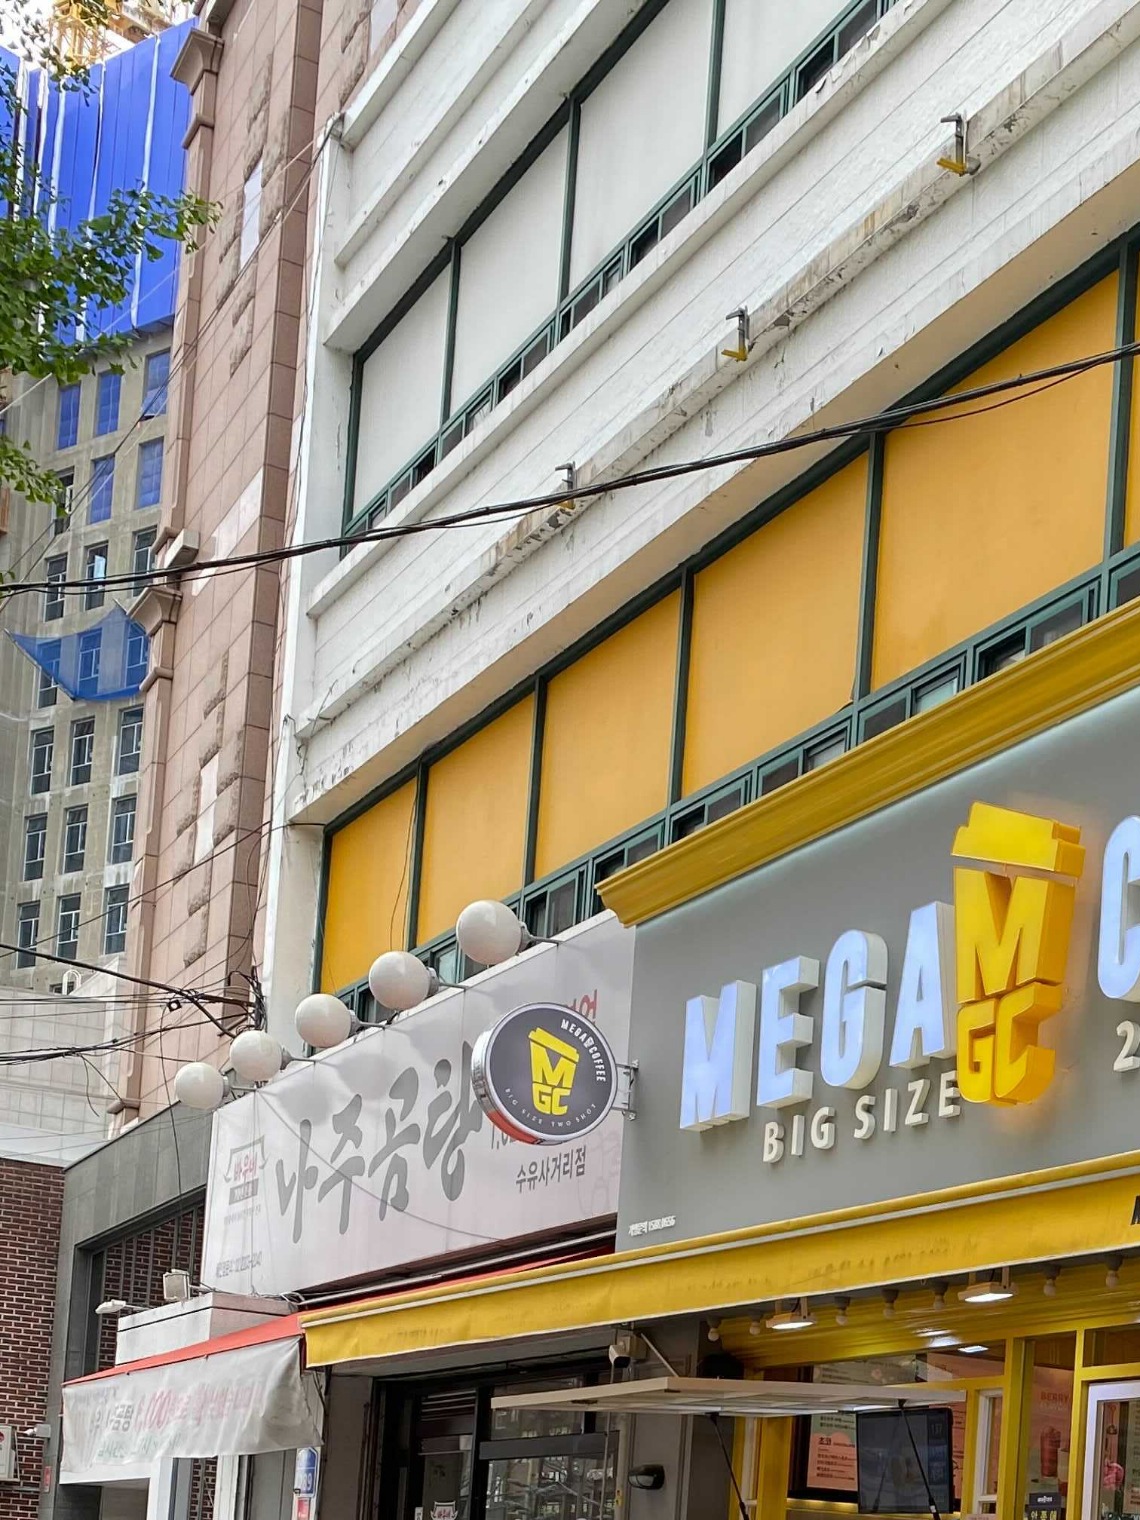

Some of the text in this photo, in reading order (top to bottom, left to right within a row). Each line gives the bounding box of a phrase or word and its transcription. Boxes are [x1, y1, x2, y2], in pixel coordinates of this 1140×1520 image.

[679, 901, 955, 1133] MEGA
[560, 1018, 585, 1043] MEGA
[588, 1044, 607, 1082] COFFEE
[504, 1087, 597, 1128] BIG SIZE TWO SHOT
[763, 1106, 836, 1163] BIG
[854, 1069, 961, 1140] SIZE
[515, 1145, 586, 1193] 수유사거리점
